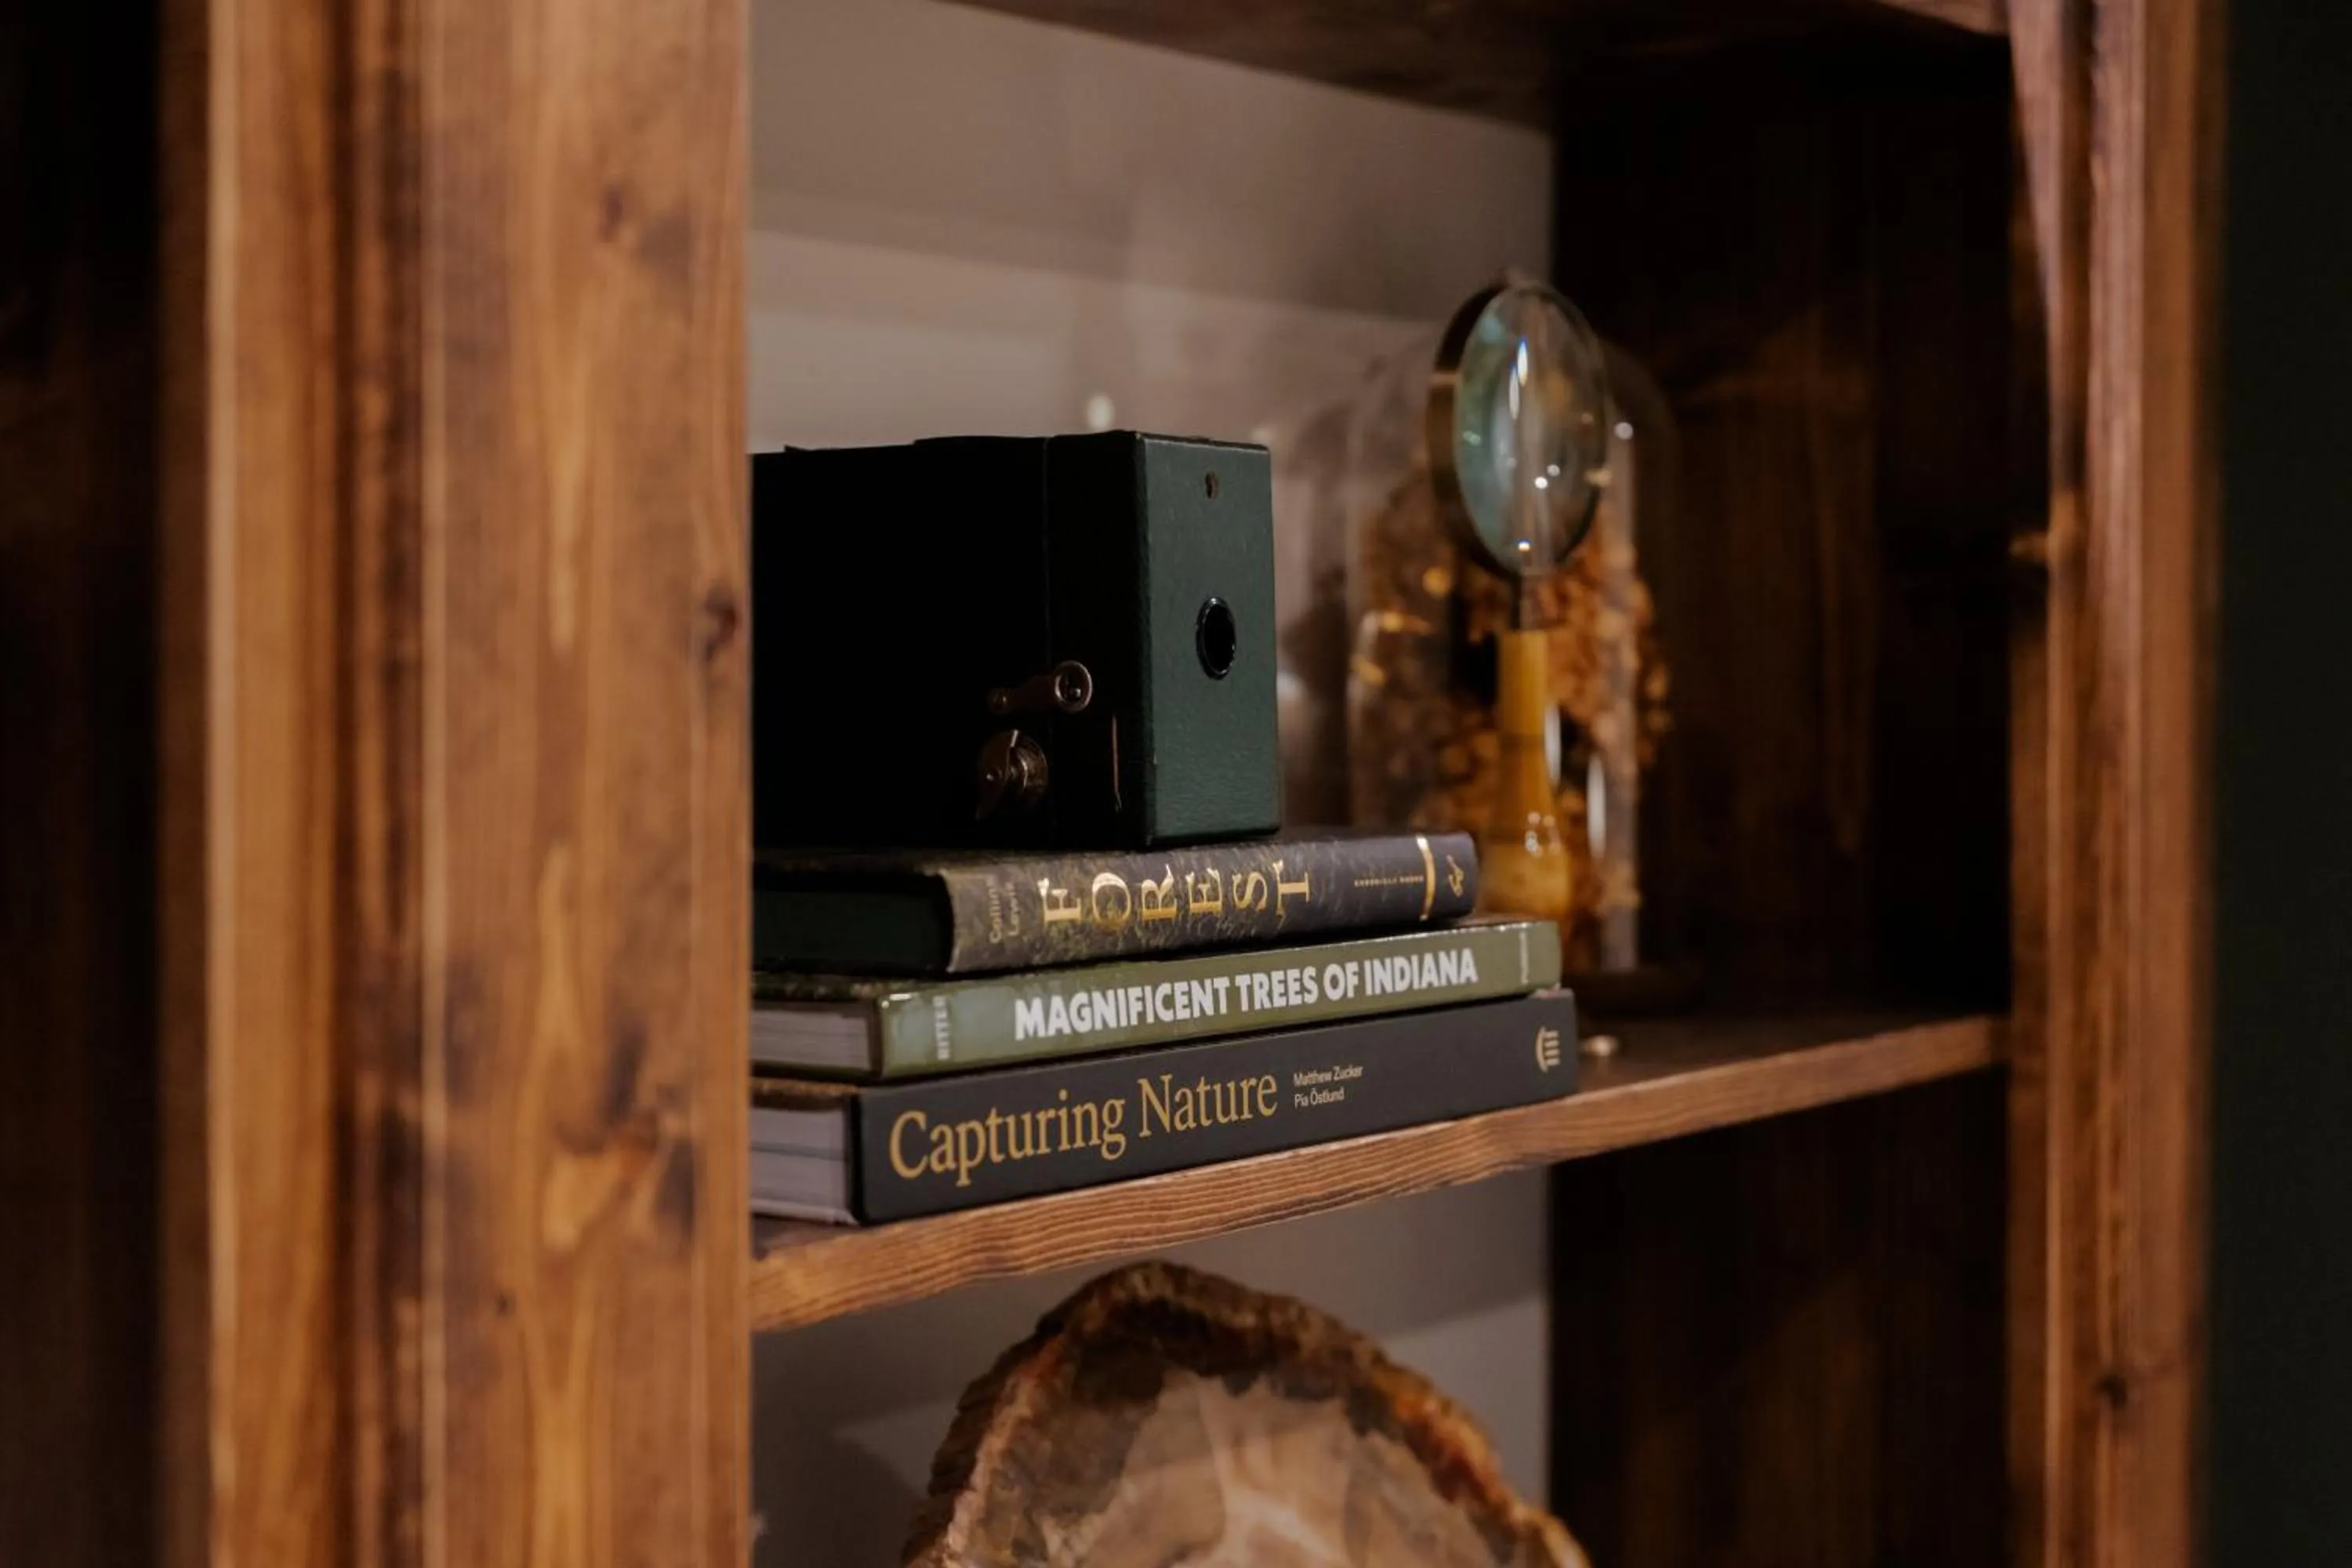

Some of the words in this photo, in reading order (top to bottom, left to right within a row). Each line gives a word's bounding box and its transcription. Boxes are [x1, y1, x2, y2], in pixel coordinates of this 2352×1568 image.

[1036, 859, 1310, 931] FOREST
[1014, 975, 1231, 1040] MAGNIFICENT
[1235, 966, 1319, 1010] TREES
[1323, 959, 1362, 1000] OF
[1365, 948, 1478, 996] INDIANA
[1293, 1071, 1332, 1088] Matthew
[1294, 1093, 1308, 1109] Pia
[889, 1089, 1127, 1186] Capturing
[1138, 1073, 1278, 1136] Nature
